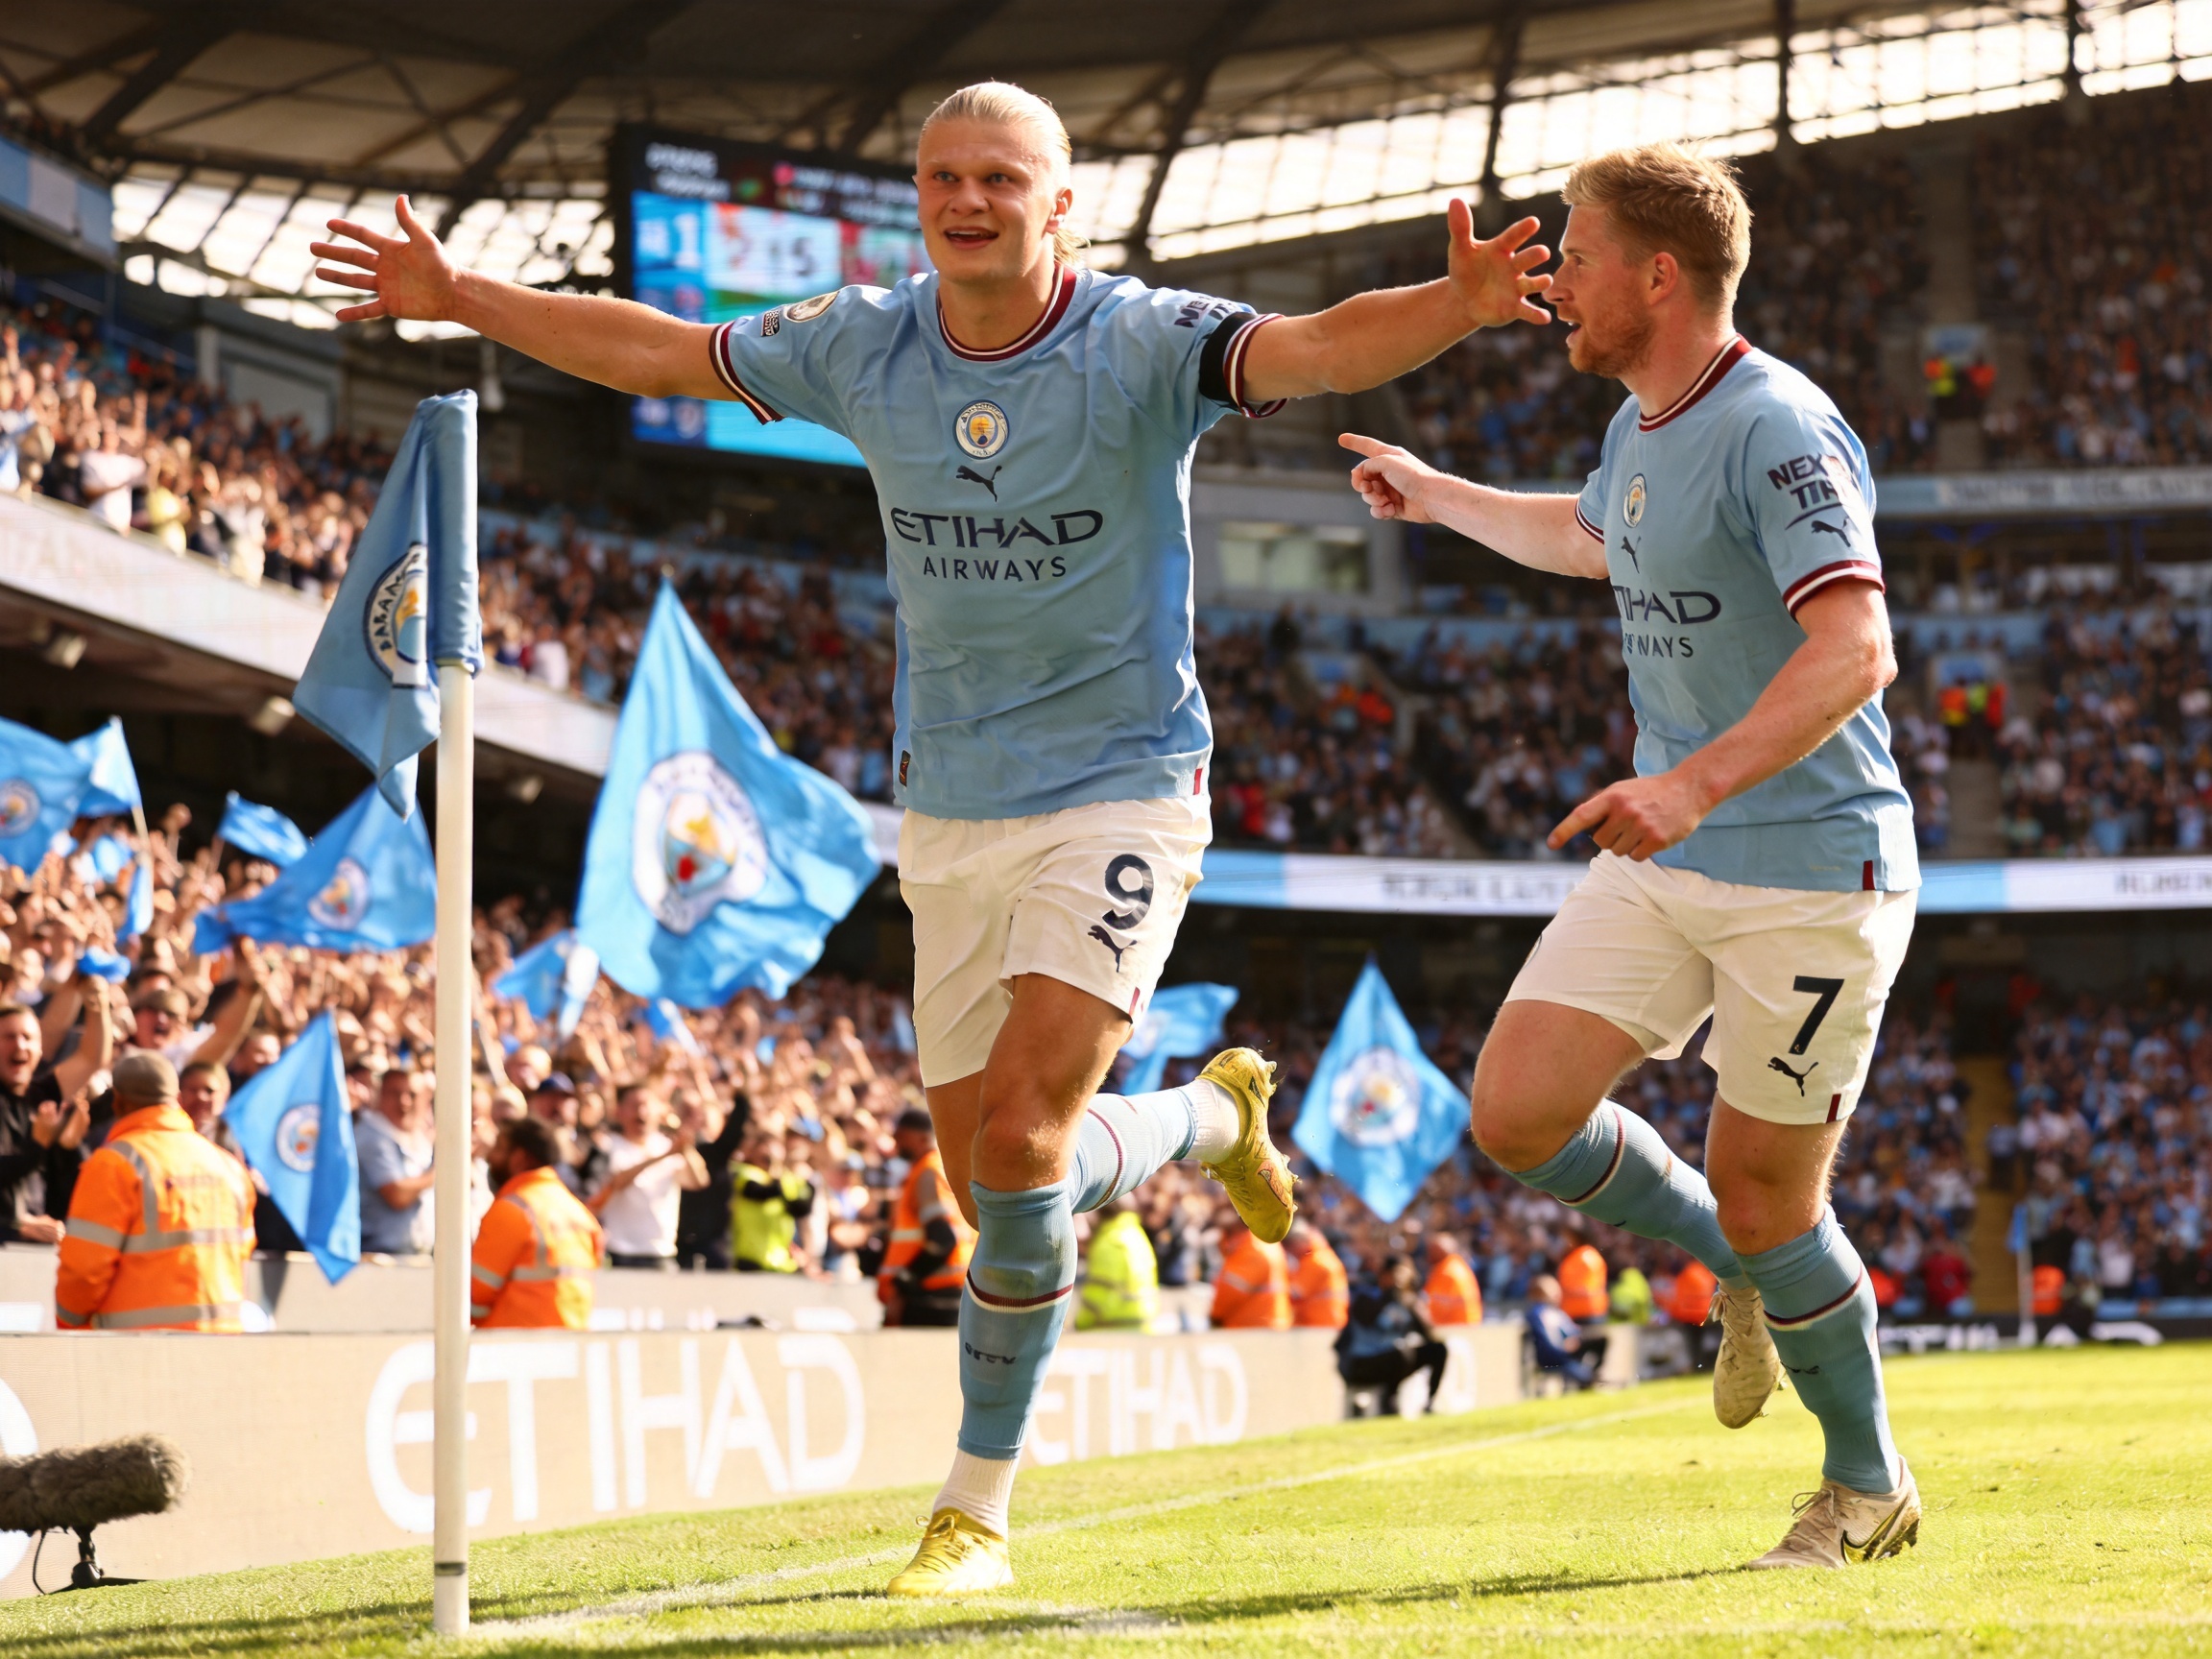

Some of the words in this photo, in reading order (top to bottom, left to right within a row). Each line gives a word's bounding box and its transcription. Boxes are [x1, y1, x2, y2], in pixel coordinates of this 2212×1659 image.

[891, 507, 1104, 548] ETIHAD
[924, 556, 1067, 582] AIRWAYS
[1102, 854, 1155, 931] 9
[1789, 975, 1845, 1056] 7
[365, 1333, 866, 1534] ETIHAD
[1030, 1343, 1247, 1467] ETIHAD
